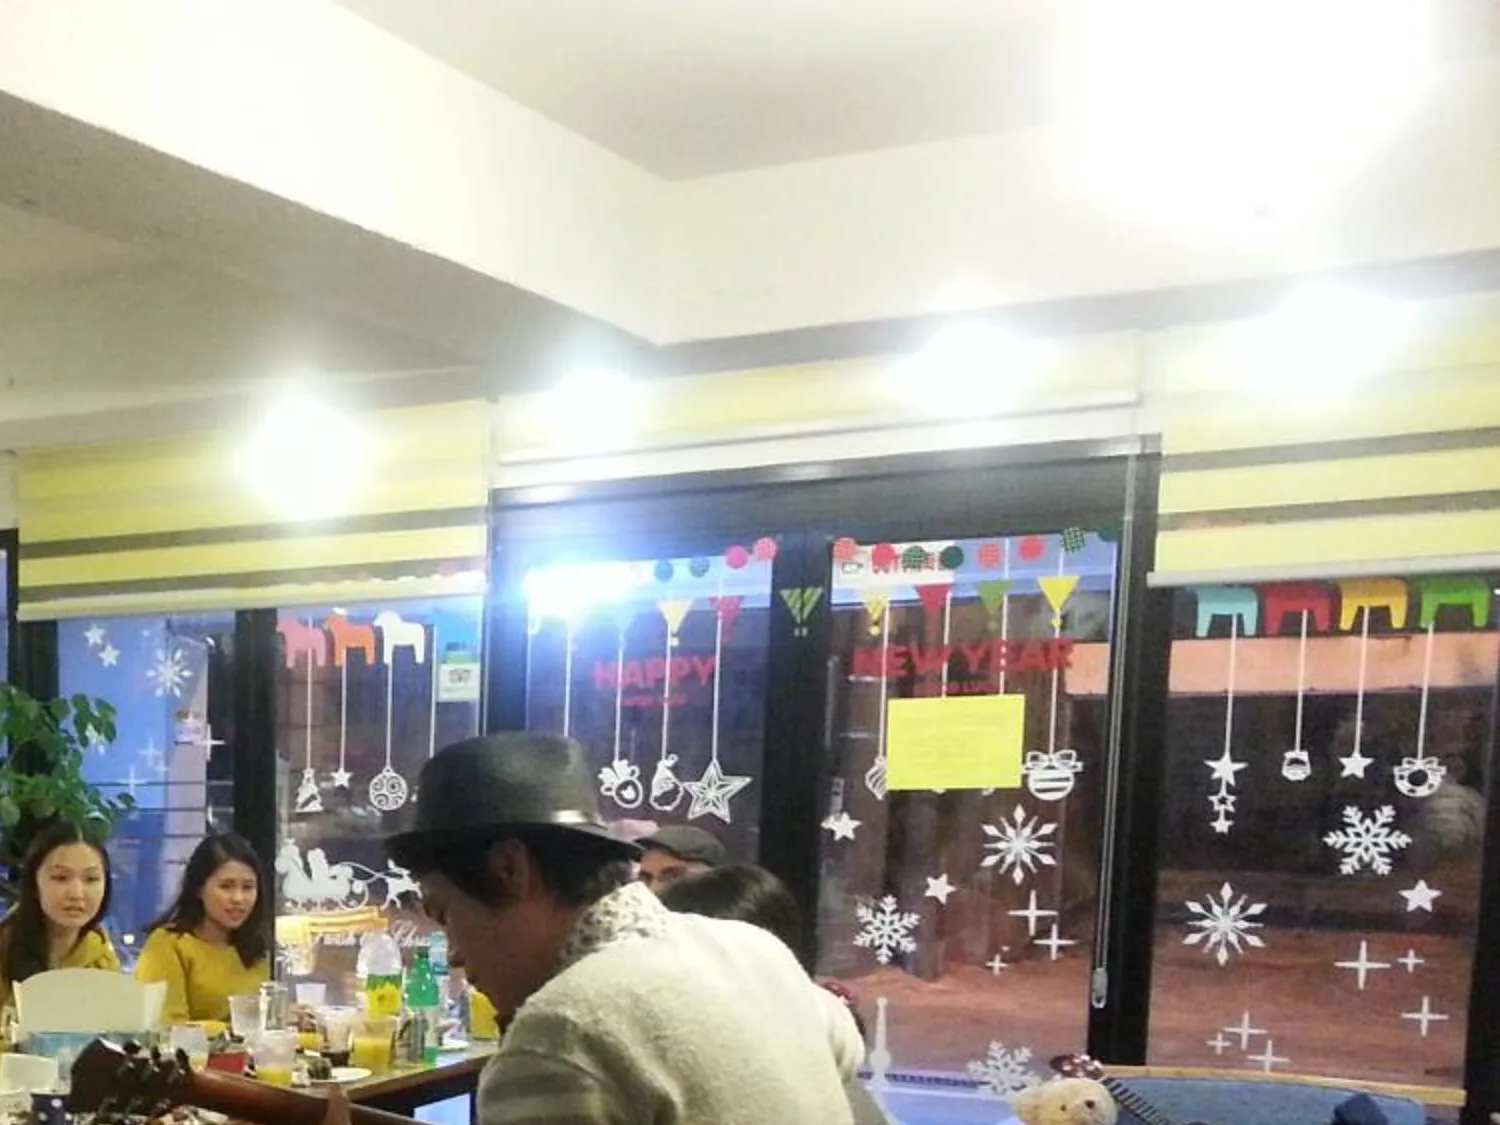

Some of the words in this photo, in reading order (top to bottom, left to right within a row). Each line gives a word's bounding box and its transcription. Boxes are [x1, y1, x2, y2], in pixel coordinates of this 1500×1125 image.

[593, 654, 717, 690] HAPPY
[852, 643, 951, 678] NEW
[954, 638, 1073, 673] YEAR
